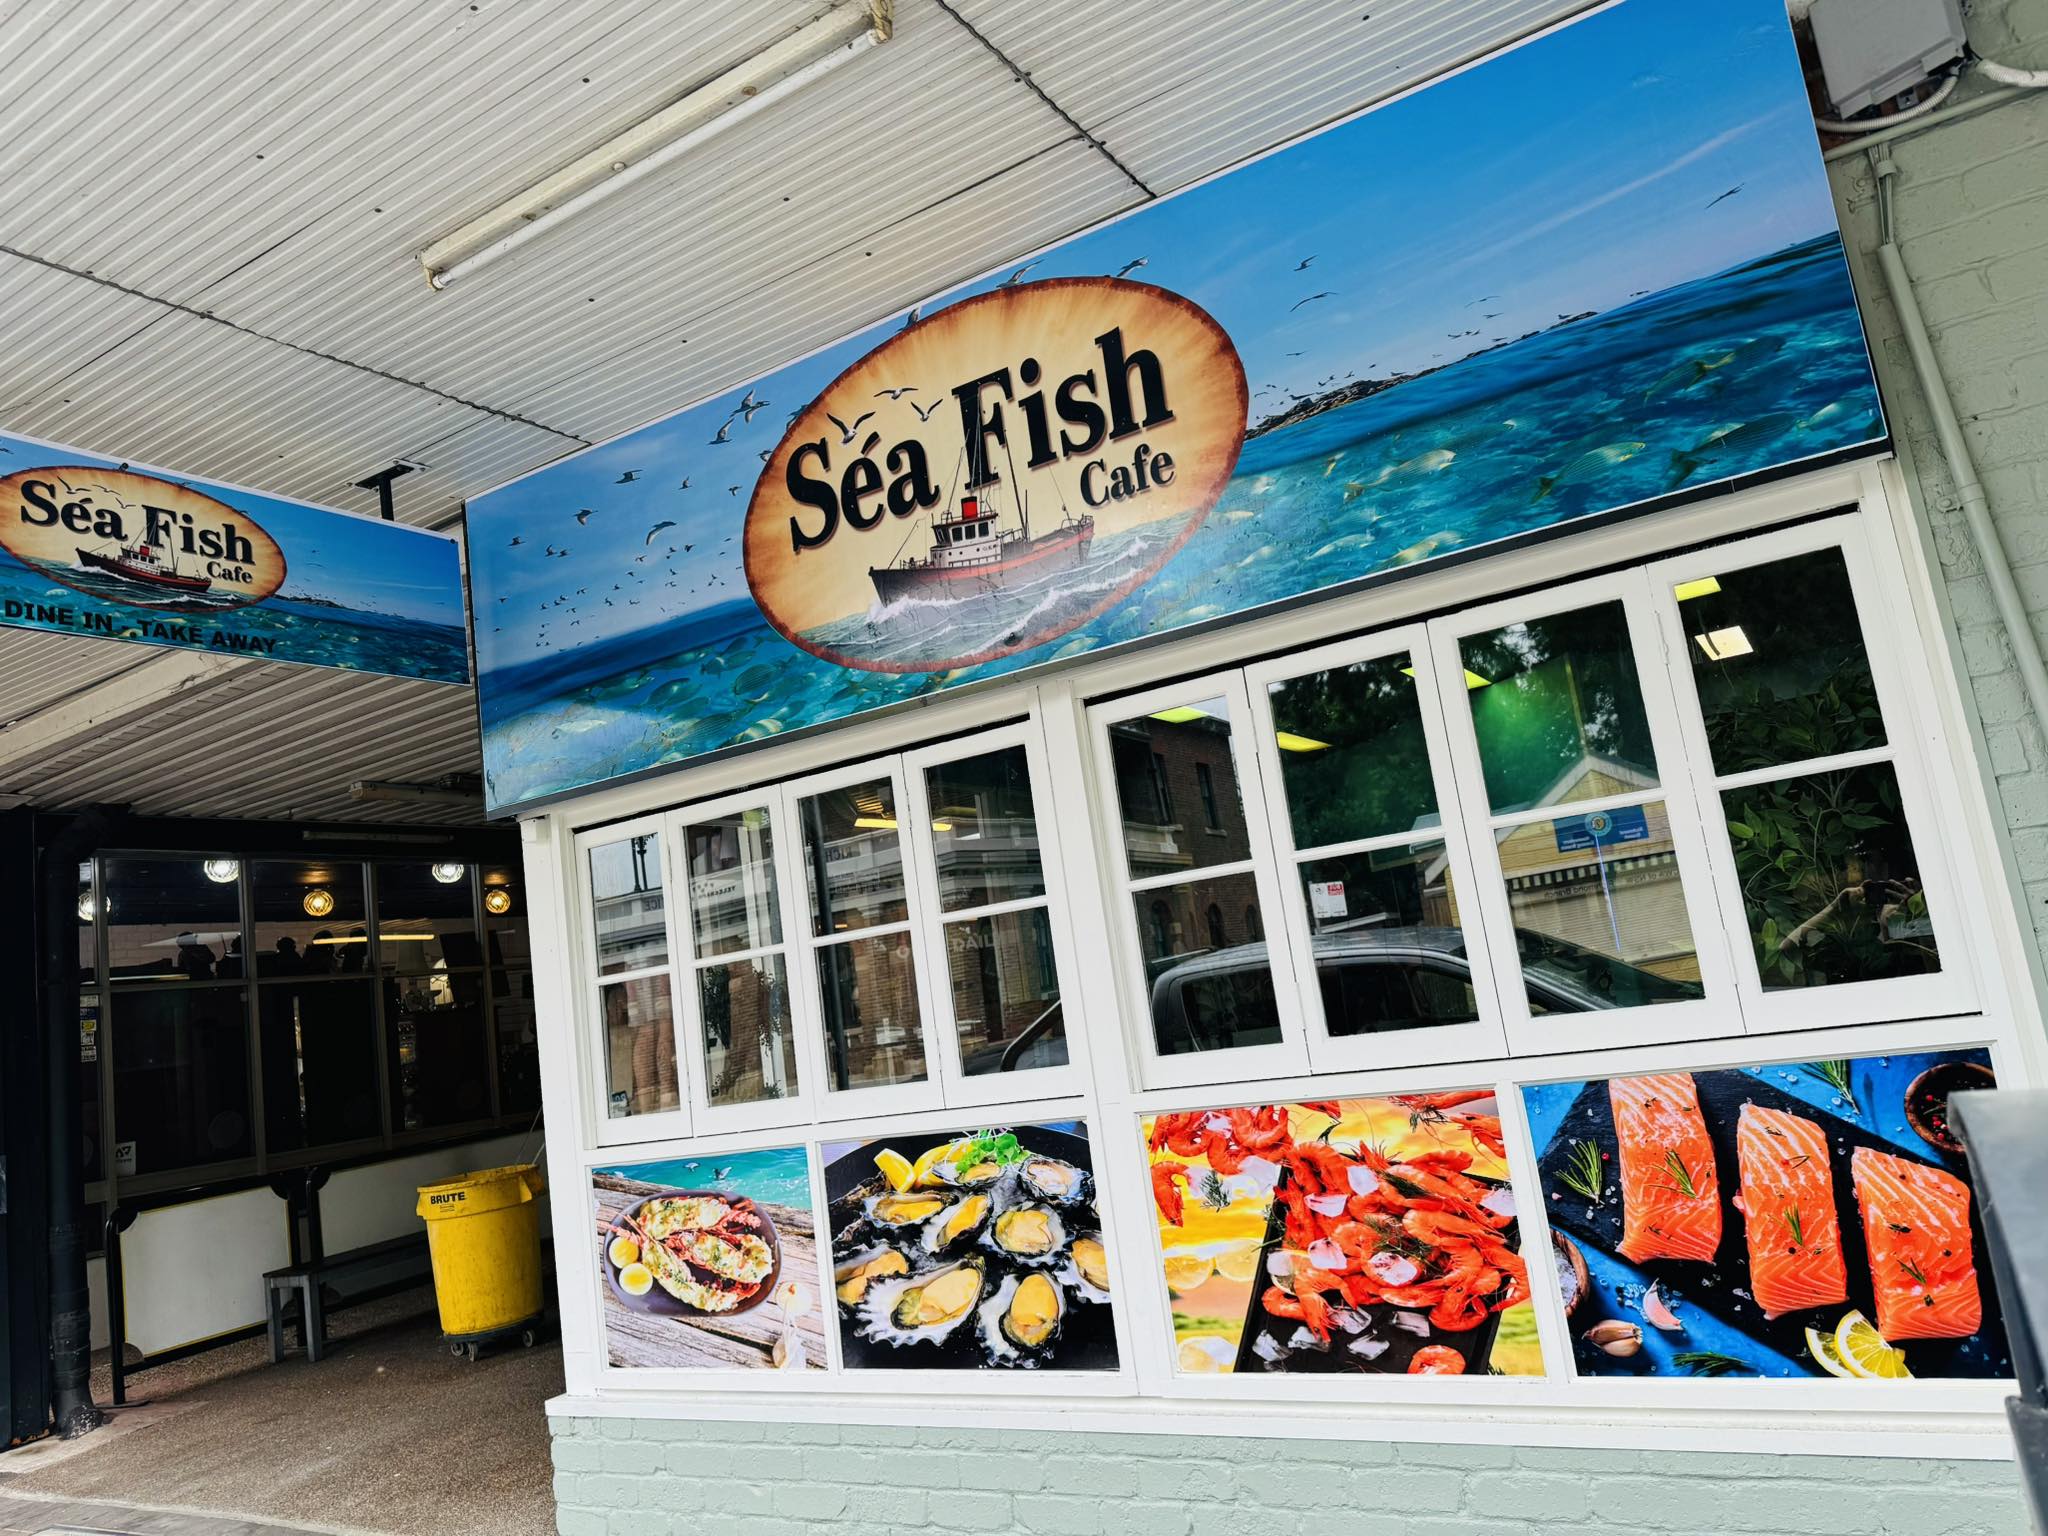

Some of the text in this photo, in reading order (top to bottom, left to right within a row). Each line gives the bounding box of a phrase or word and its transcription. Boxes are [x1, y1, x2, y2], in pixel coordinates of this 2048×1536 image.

[952, 326, 1174, 491] Fish
[1080, 443, 1175, 507] Cafe
[141, 503, 256, 566] Fish
[206, 560, 253, 584] Cafe
[4, 599, 74, 626] DINE
[83, 611, 113, 632] IN
[137, 619, 203, 644] TAKE
[211, 631, 277, 653] AWAY
[430, 1191, 465, 1205] BRUTE
